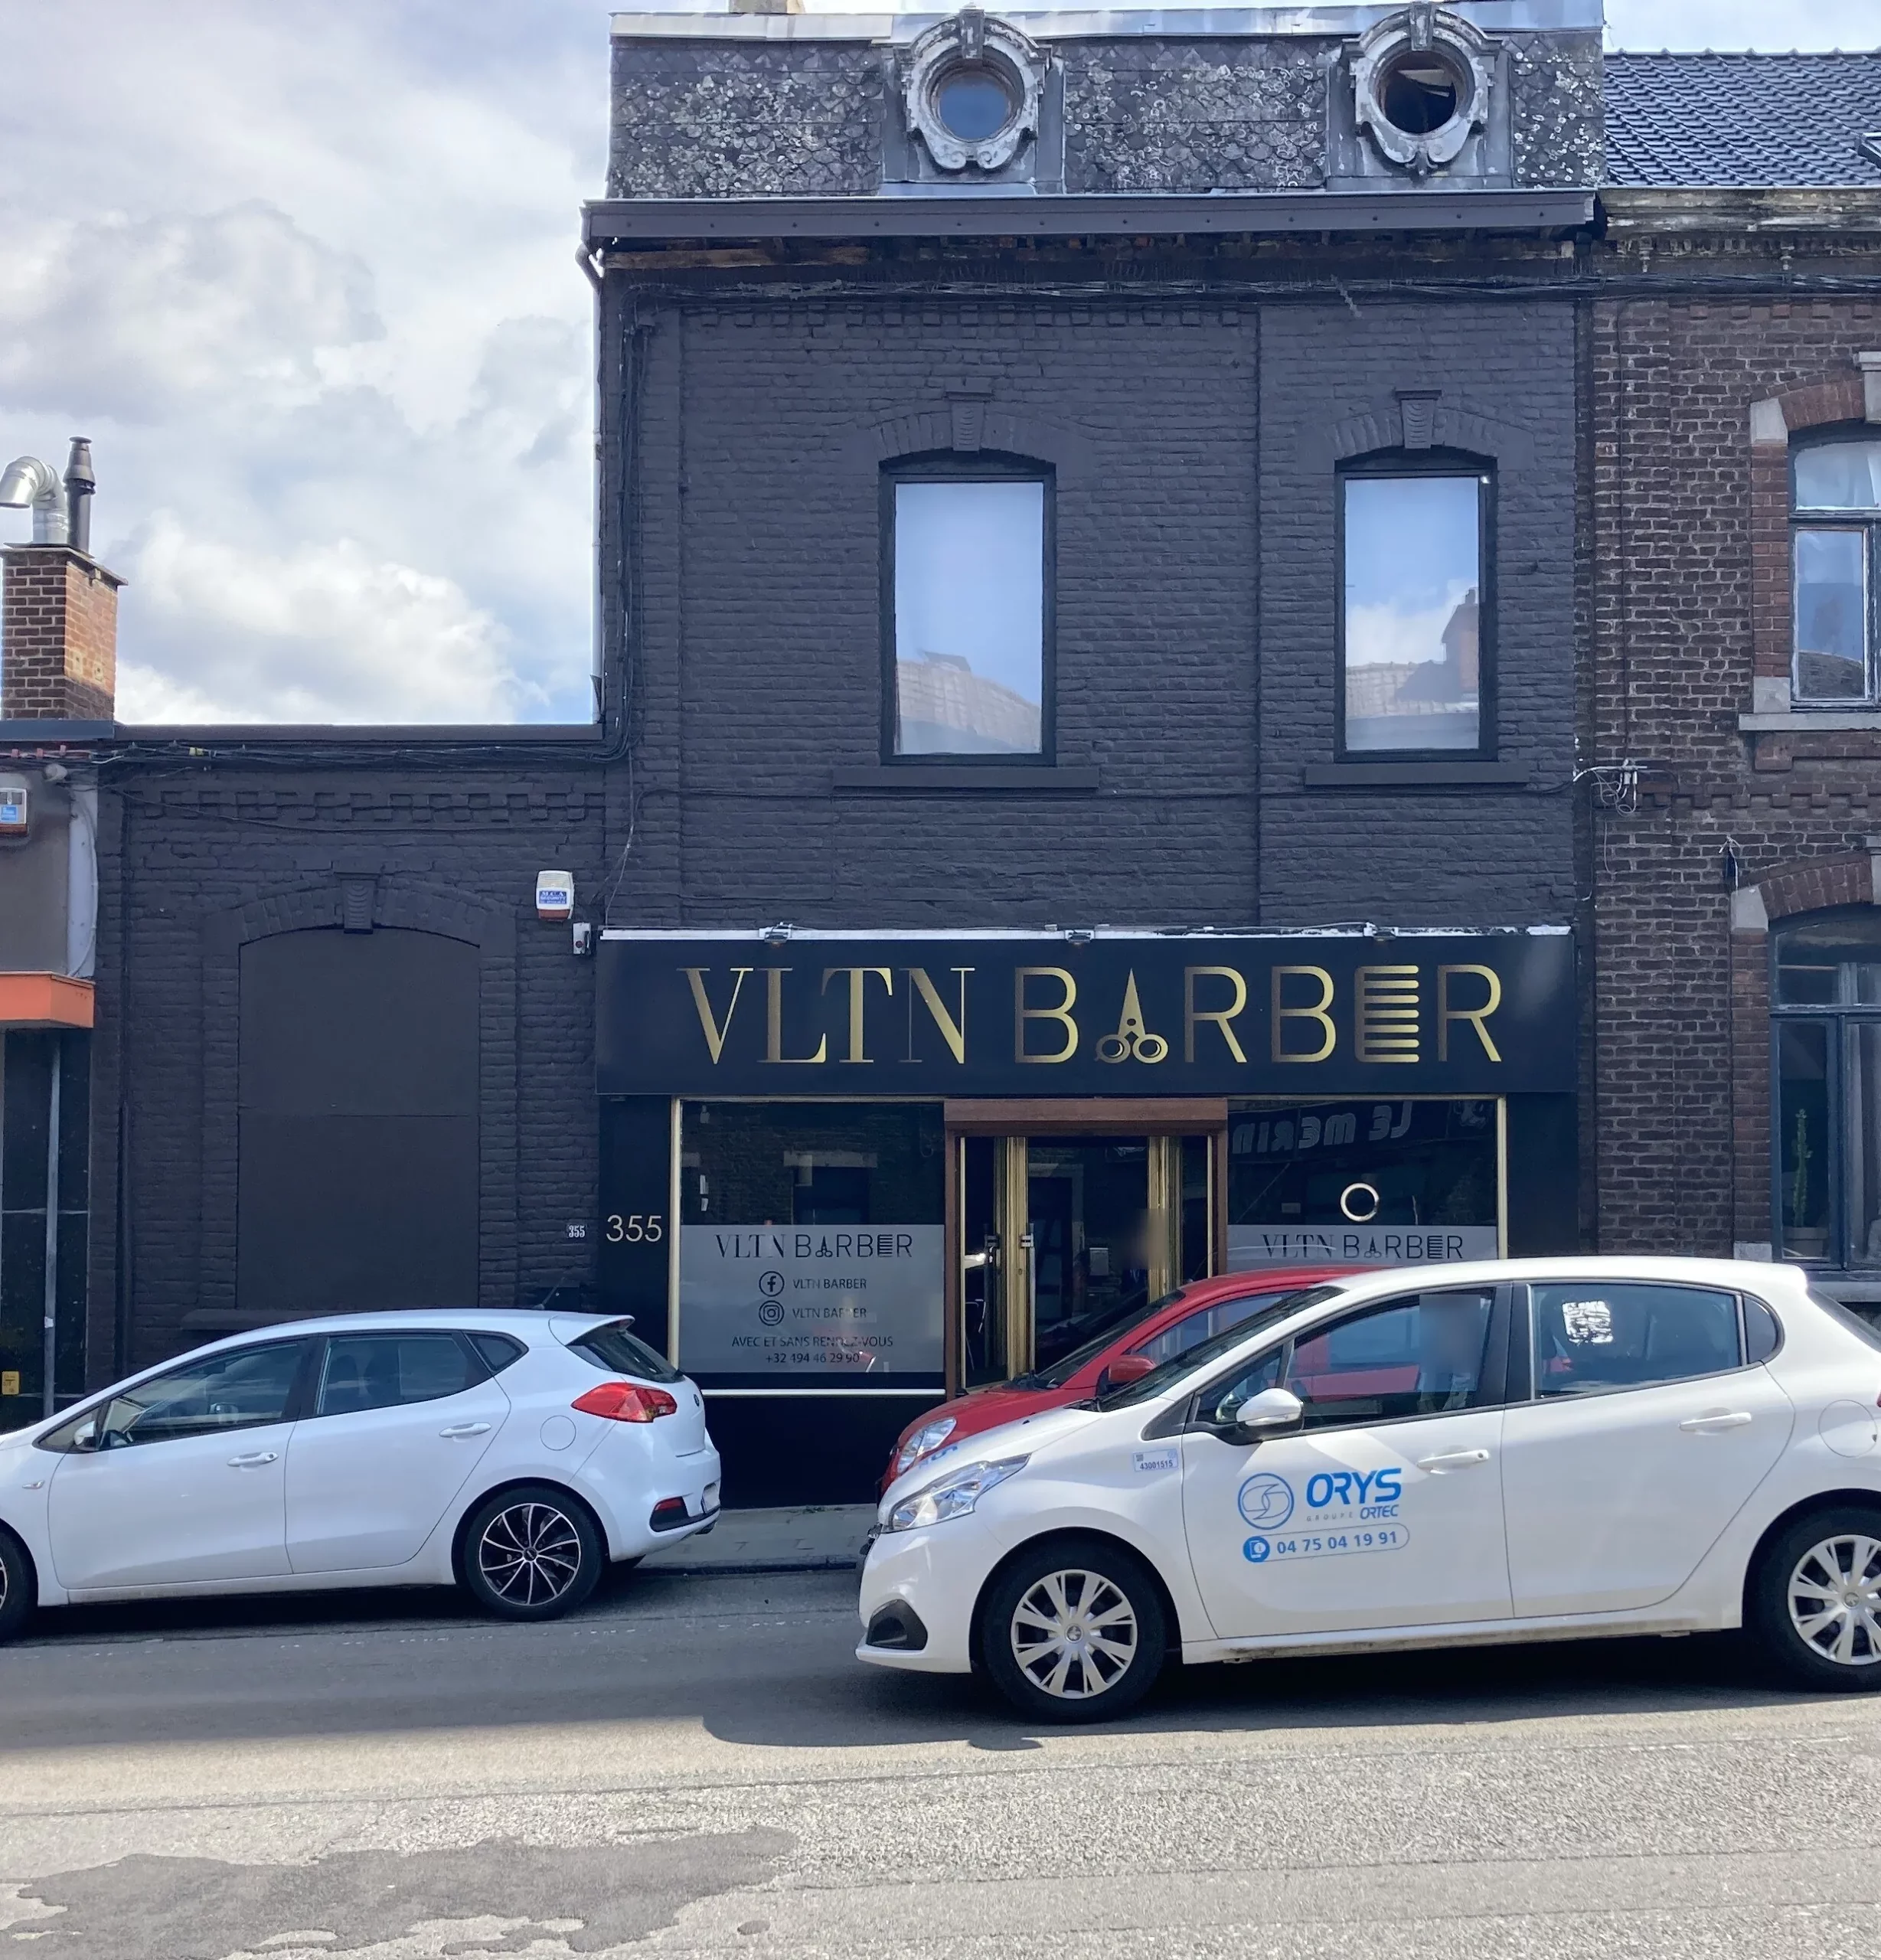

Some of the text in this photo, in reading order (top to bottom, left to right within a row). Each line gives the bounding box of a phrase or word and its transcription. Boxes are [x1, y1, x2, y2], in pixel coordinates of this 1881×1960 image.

[676, 965, 1502, 1064] VLTN BARBER
[568, 1225, 586, 1238] 355
[606, 1214, 662, 1242] 355
[715, 1233, 913, 1258] VLTN BARBER
[1261, 1233, 1463, 1259] VLTN BARBER
[793, 1279, 867, 1289] VLTN BARBER
[792, 1308, 820, 1318] VLTN
[732, 1336, 761, 1347] AVEC
[764, 1337, 776, 1347] ET
[780, 1336, 810, 1347] SANS
[766, 1353, 786, 1363] +32
[790, 1353, 809, 1363] 494
[813, 1353, 826, 1363] 46
[830, 1353, 843, 1363] 29
[1140, 1459, 1173, 1469] 43001515
[1306, 1468, 1402, 1508] ORYS
[1360, 1504, 1399, 1520] ORTEC
[1277, 1531, 1396, 1554] 04 75 04 19 91
